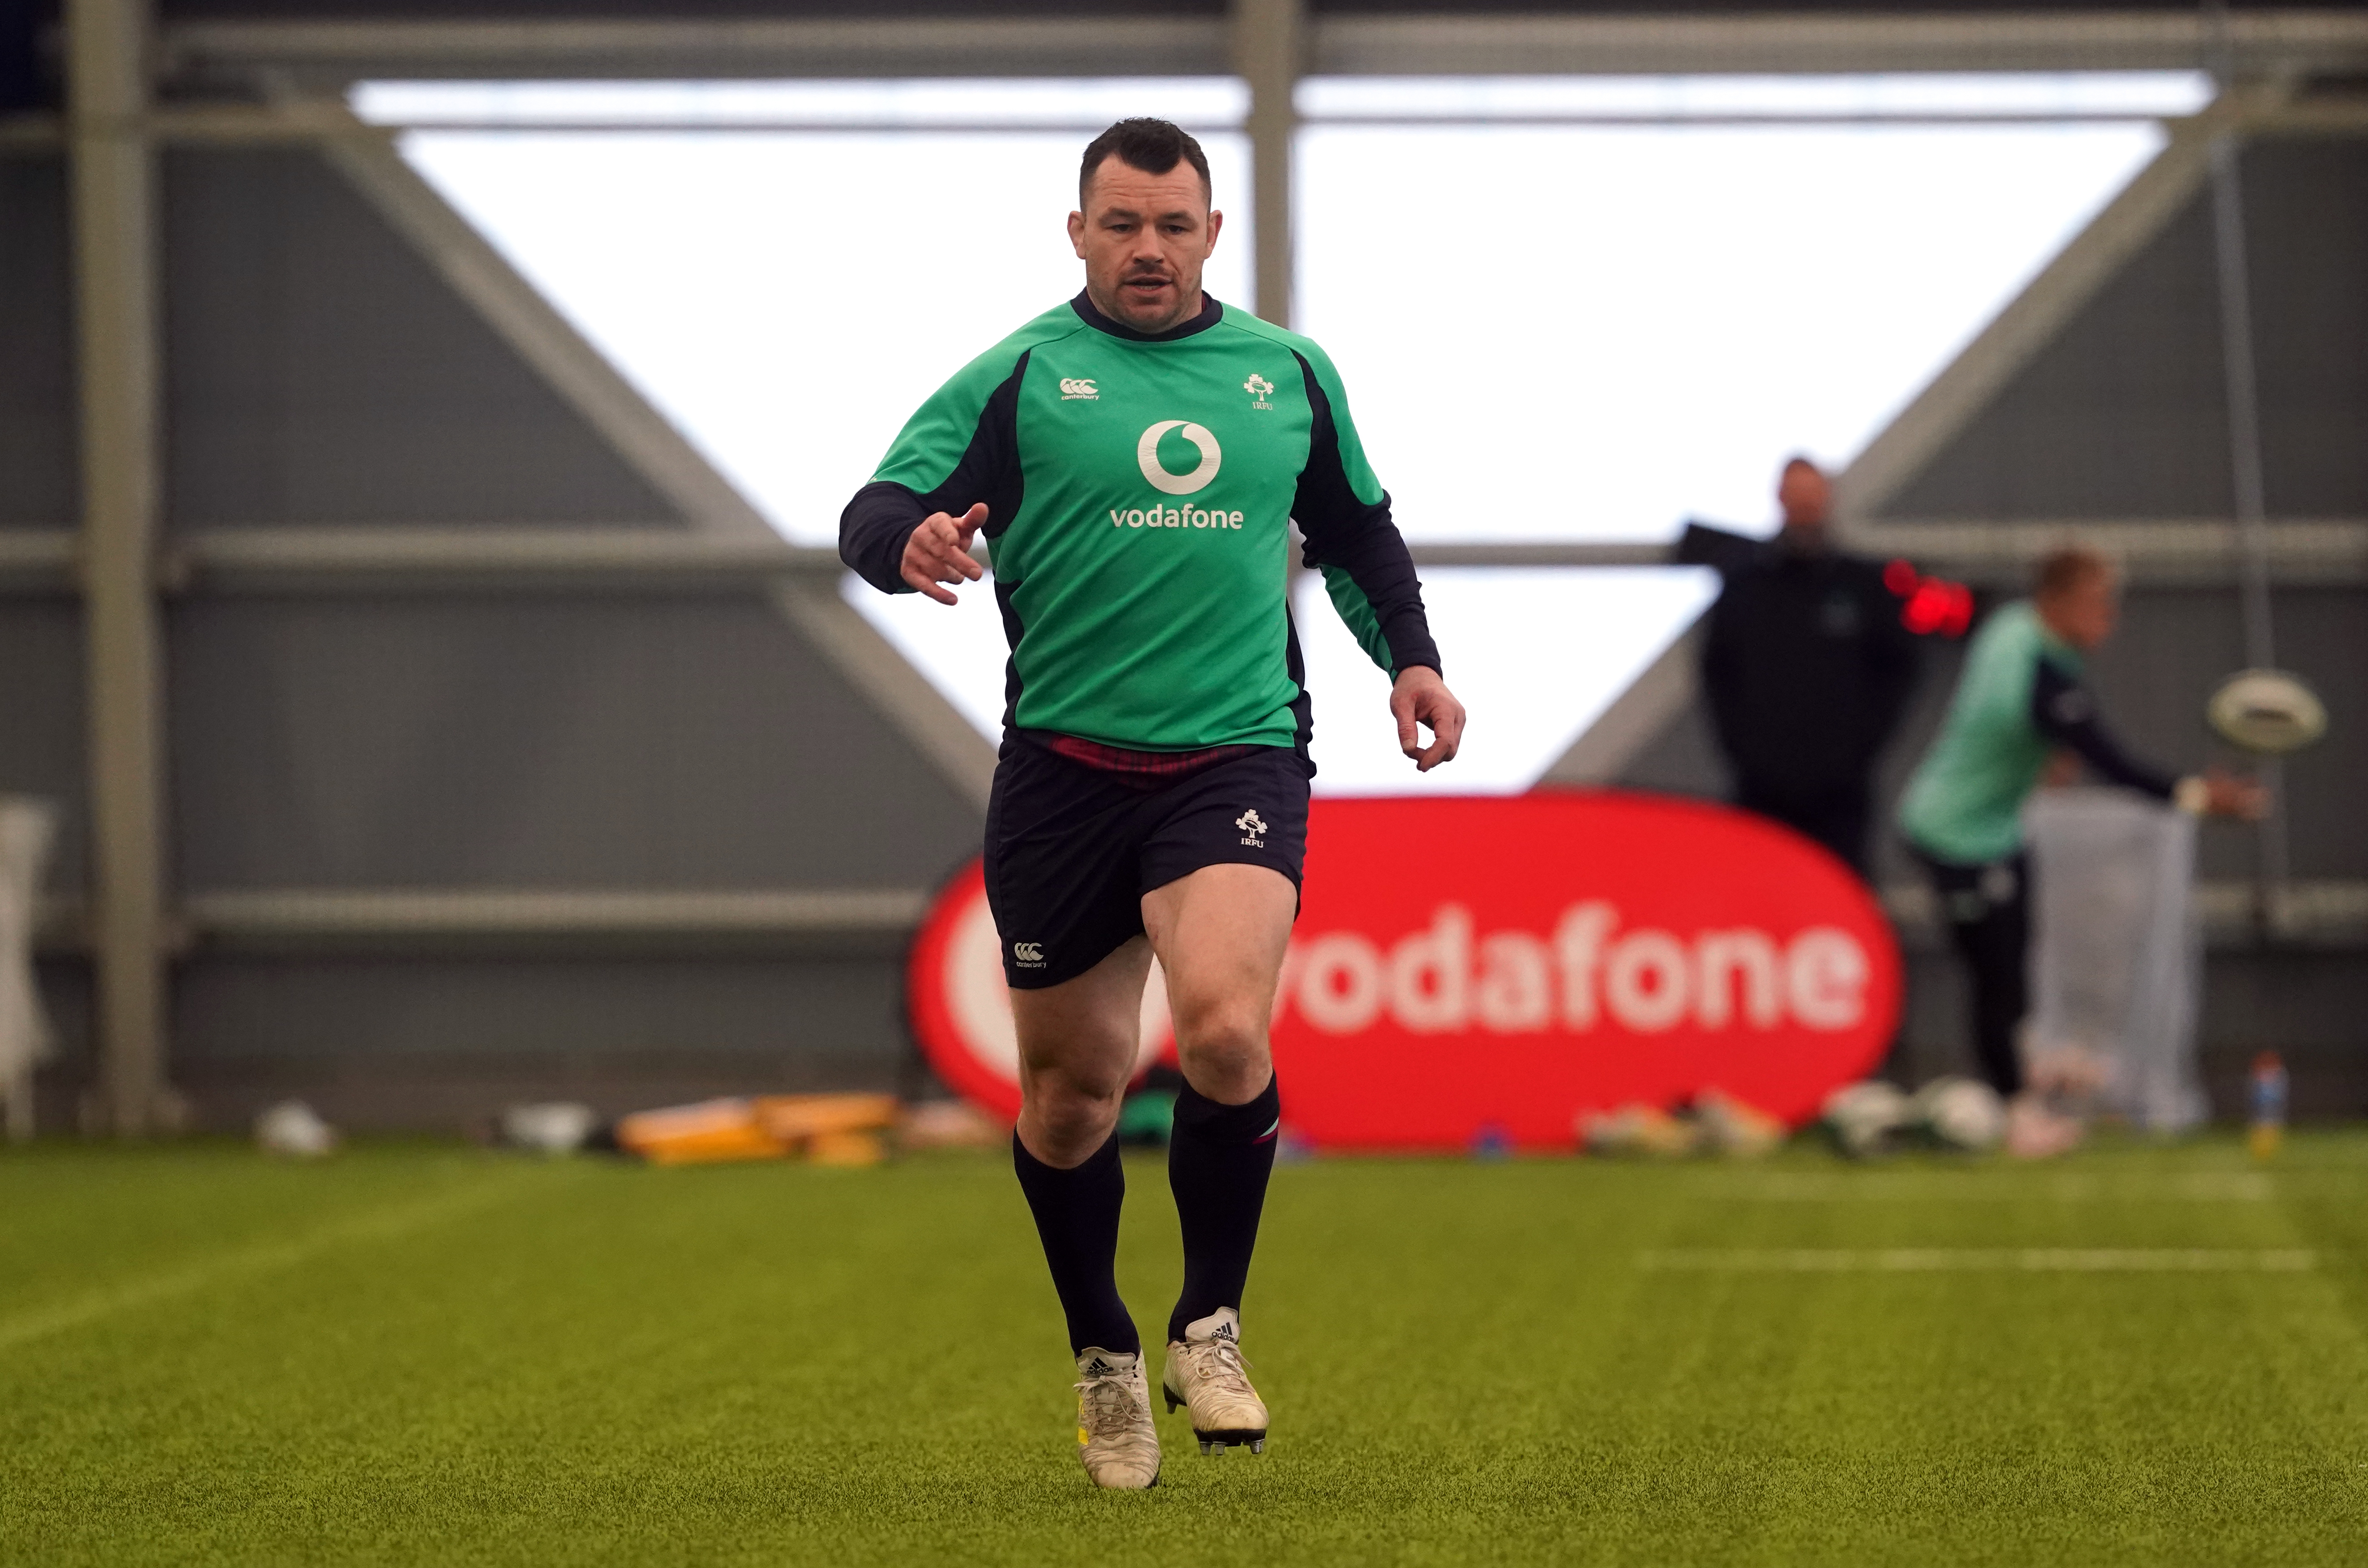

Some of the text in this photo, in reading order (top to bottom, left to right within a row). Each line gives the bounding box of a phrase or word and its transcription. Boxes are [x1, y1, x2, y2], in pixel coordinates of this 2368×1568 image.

[1252, 402, 1273, 410] IRFU
[1110, 503, 1244, 529] vodafone
[1241, 837, 1264, 848] IRFU
[1212, 1331, 1234, 1342] adidas
